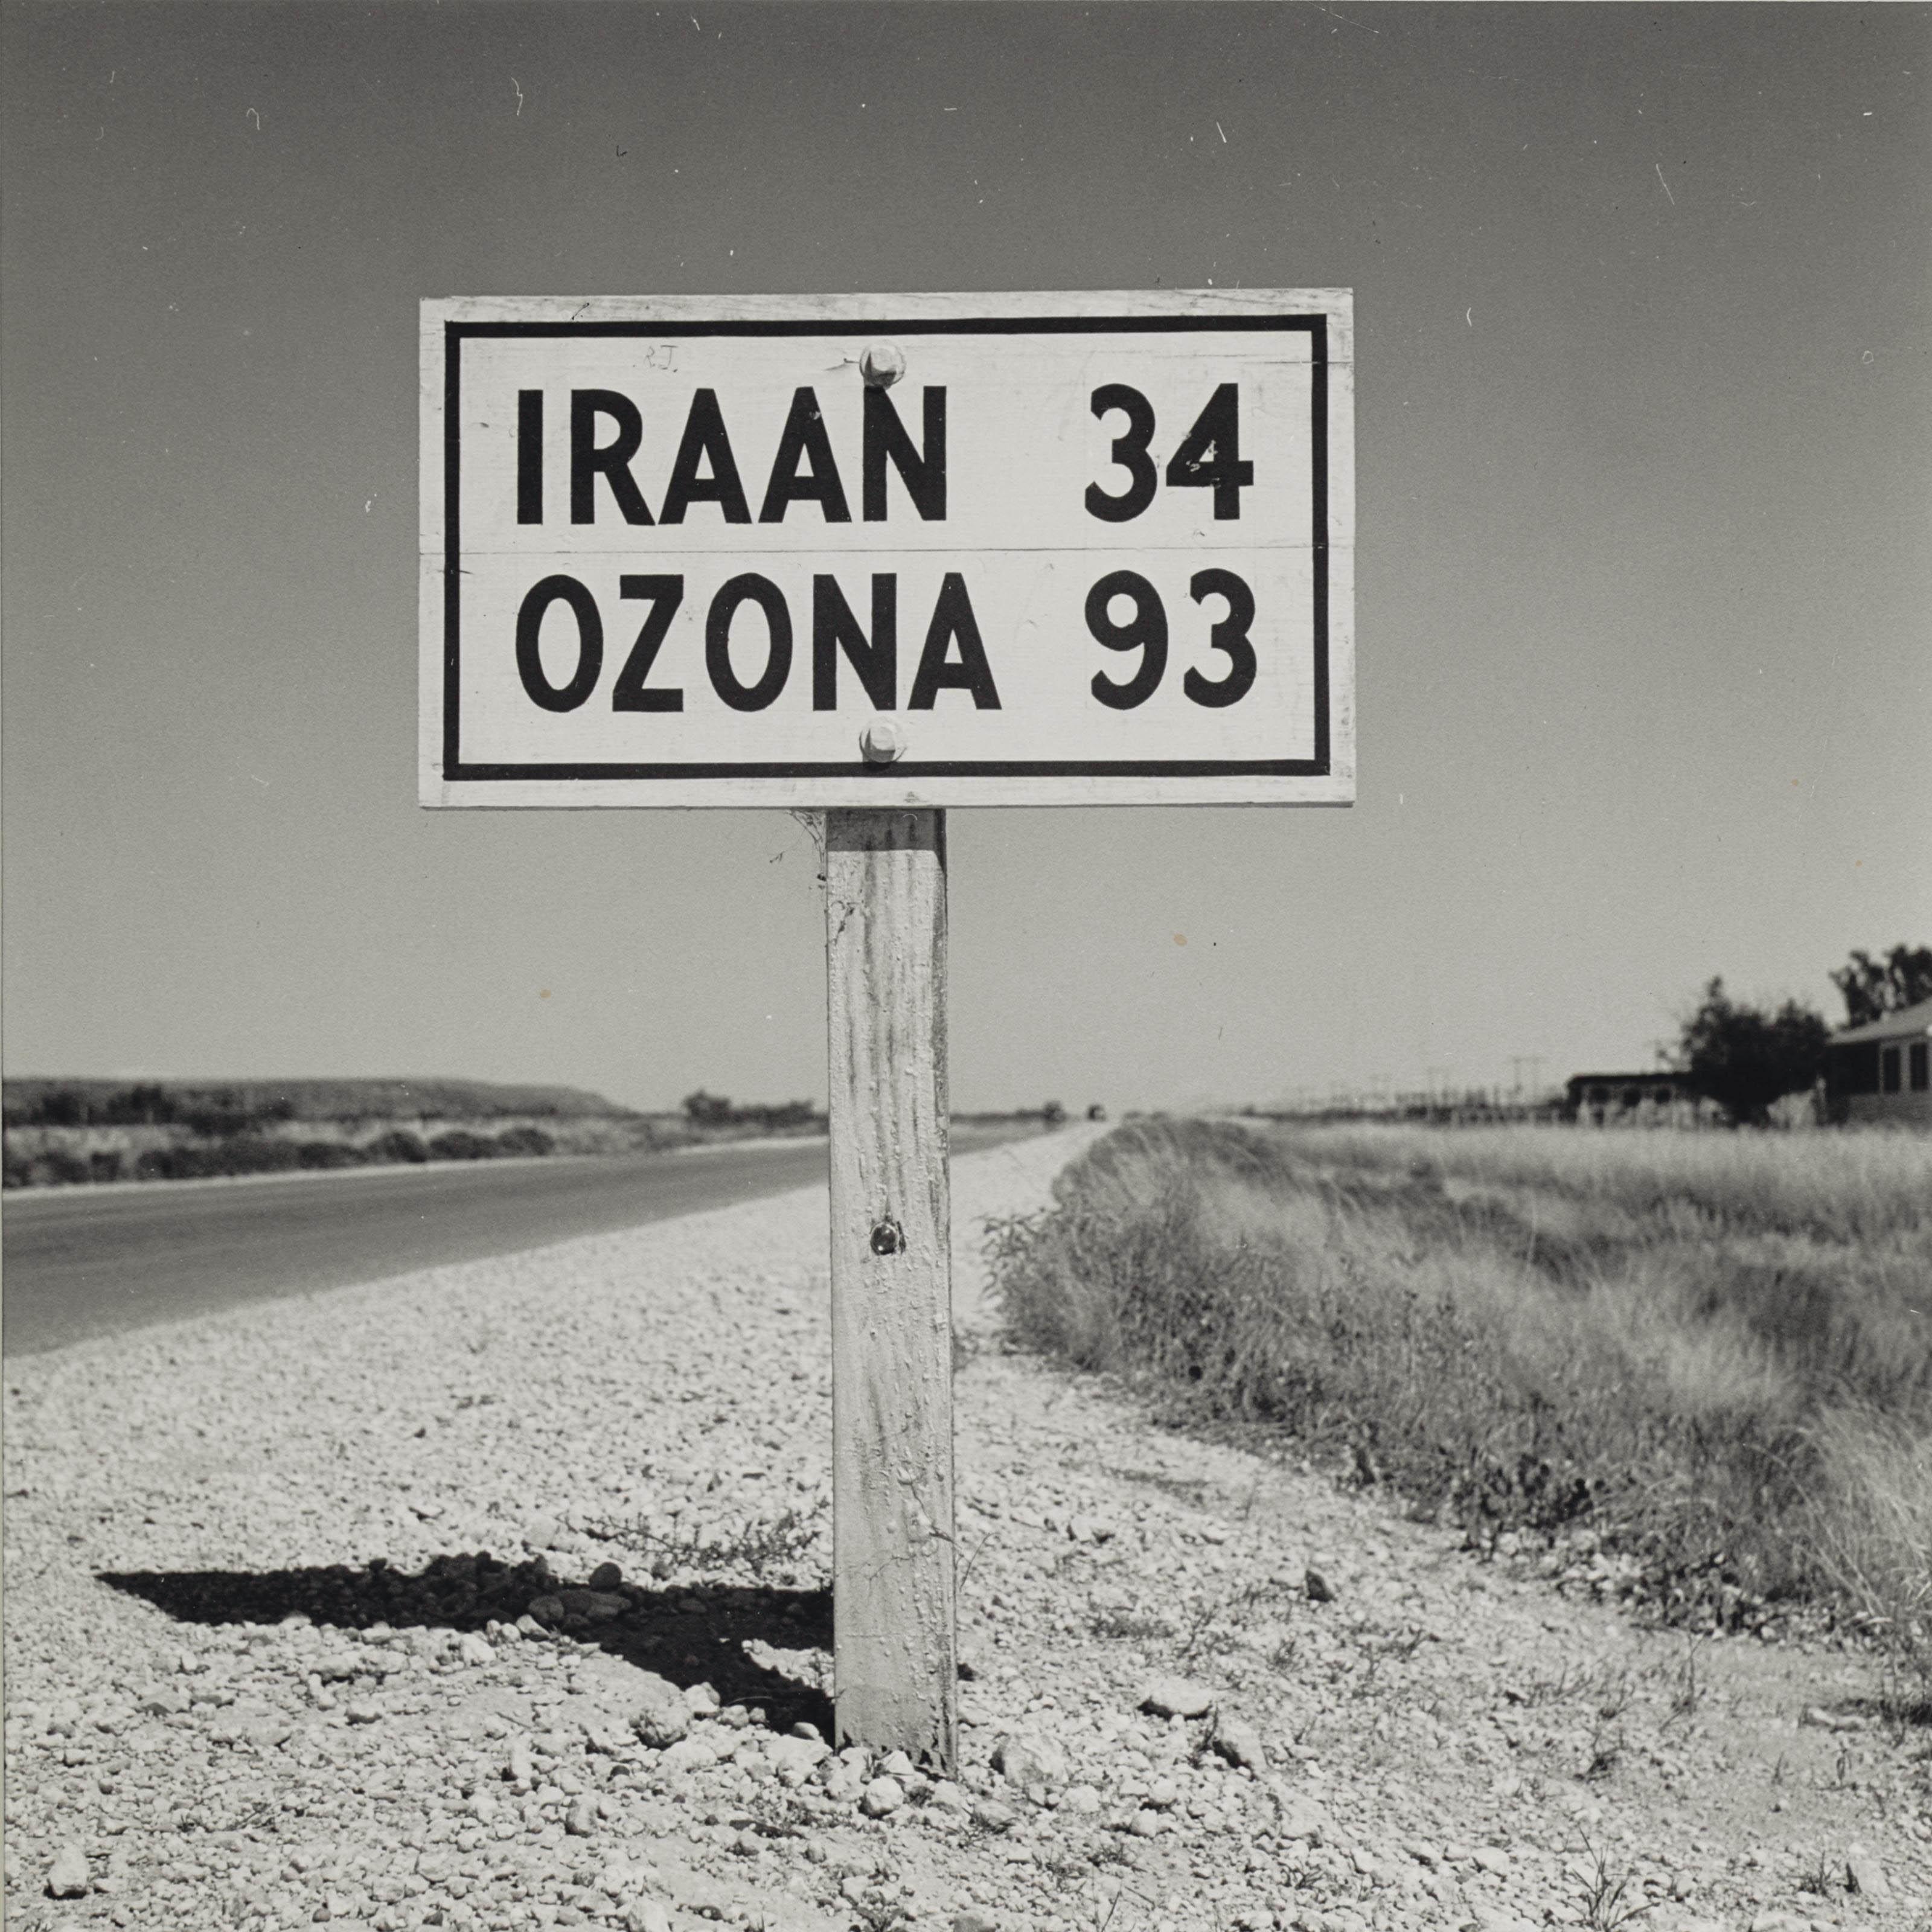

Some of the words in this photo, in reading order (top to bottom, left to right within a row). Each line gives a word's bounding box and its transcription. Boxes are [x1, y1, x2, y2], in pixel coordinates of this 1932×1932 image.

[516, 386, 947, 526] IRAAN
[1084, 382, 1254, 523] 34
[515, 571, 1002, 713] OZONA
[1084, 568, 1258, 711] 93
